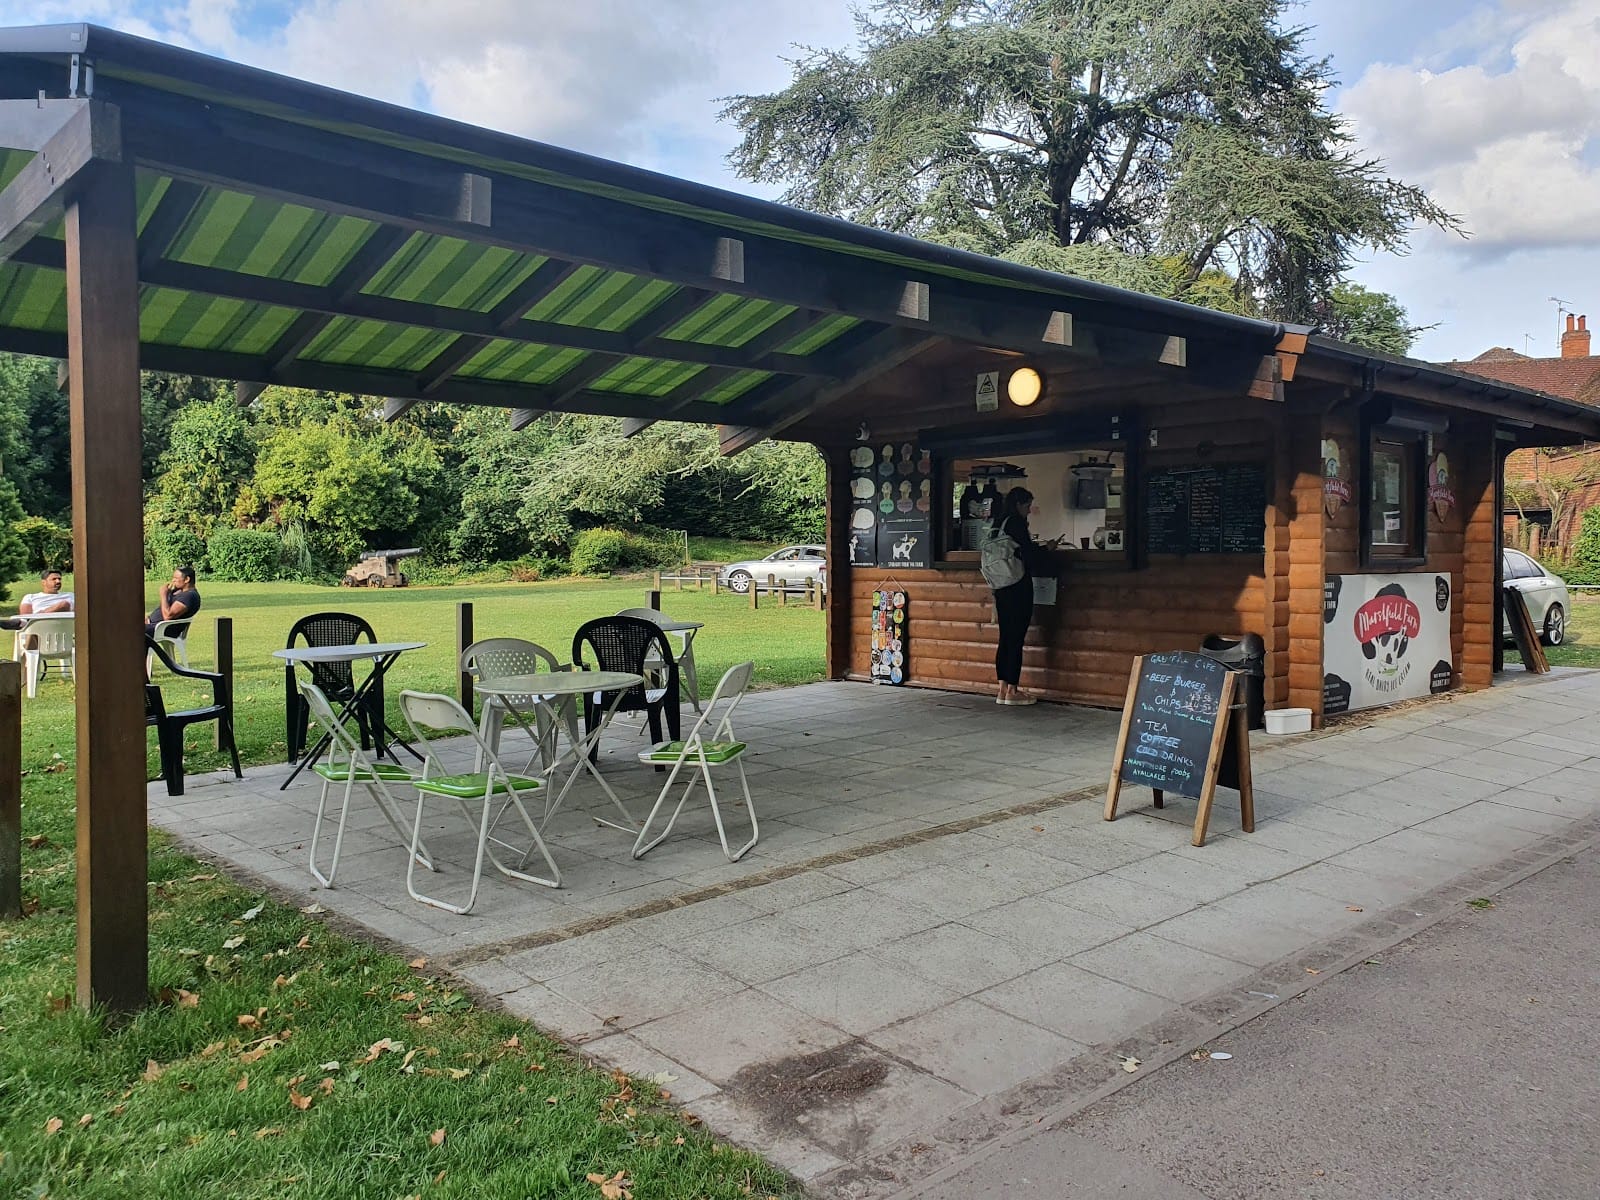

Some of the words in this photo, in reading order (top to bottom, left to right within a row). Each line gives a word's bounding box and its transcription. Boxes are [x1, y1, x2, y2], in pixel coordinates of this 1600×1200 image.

[1359, 602, 1402, 638] Marshfield
[1402, 603, 1418, 630] Farm
[1149, 673, 1172, 683] BEEF
[1174, 675, 1206, 691] BURGER
[1155, 695, 1181, 710] CHIPS
[1145, 720, 1169, 733] TEA
[1140, 732, 1182, 749] COFFEE
[1136, 744, 1158, 757] COLD
[1161, 752, 1194, 767] DRINKS
[1132, 768, 1166, 782] AVAILABLE
